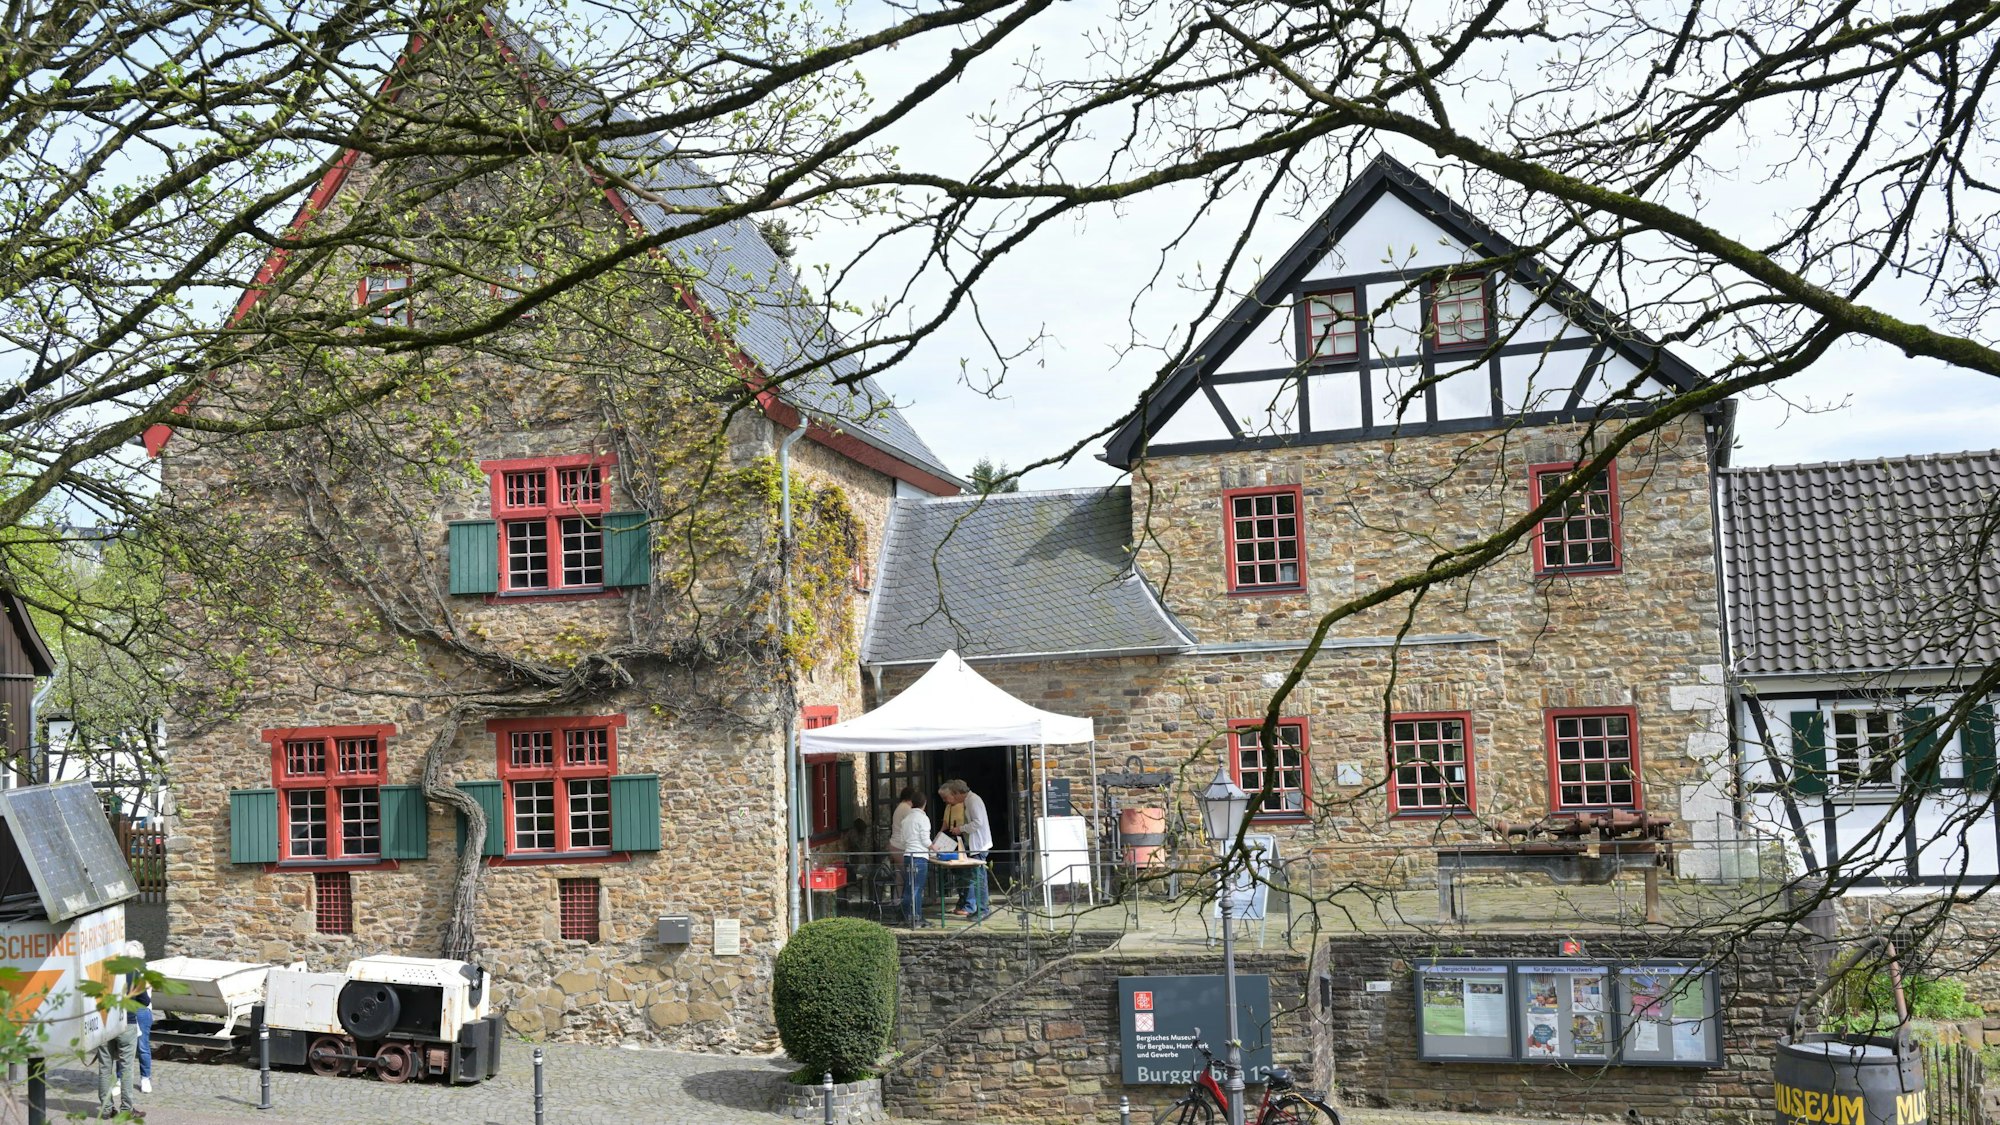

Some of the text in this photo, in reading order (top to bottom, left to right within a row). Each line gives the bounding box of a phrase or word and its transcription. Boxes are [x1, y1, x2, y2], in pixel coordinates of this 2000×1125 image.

[0, 931, 77, 960] SCHEINE
[1136, 1034, 1170, 1042] Bergisches
[1147, 1043, 1176, 1051] Bergbau,
[1774, 1080, 1865, 1125] MUSEUM
